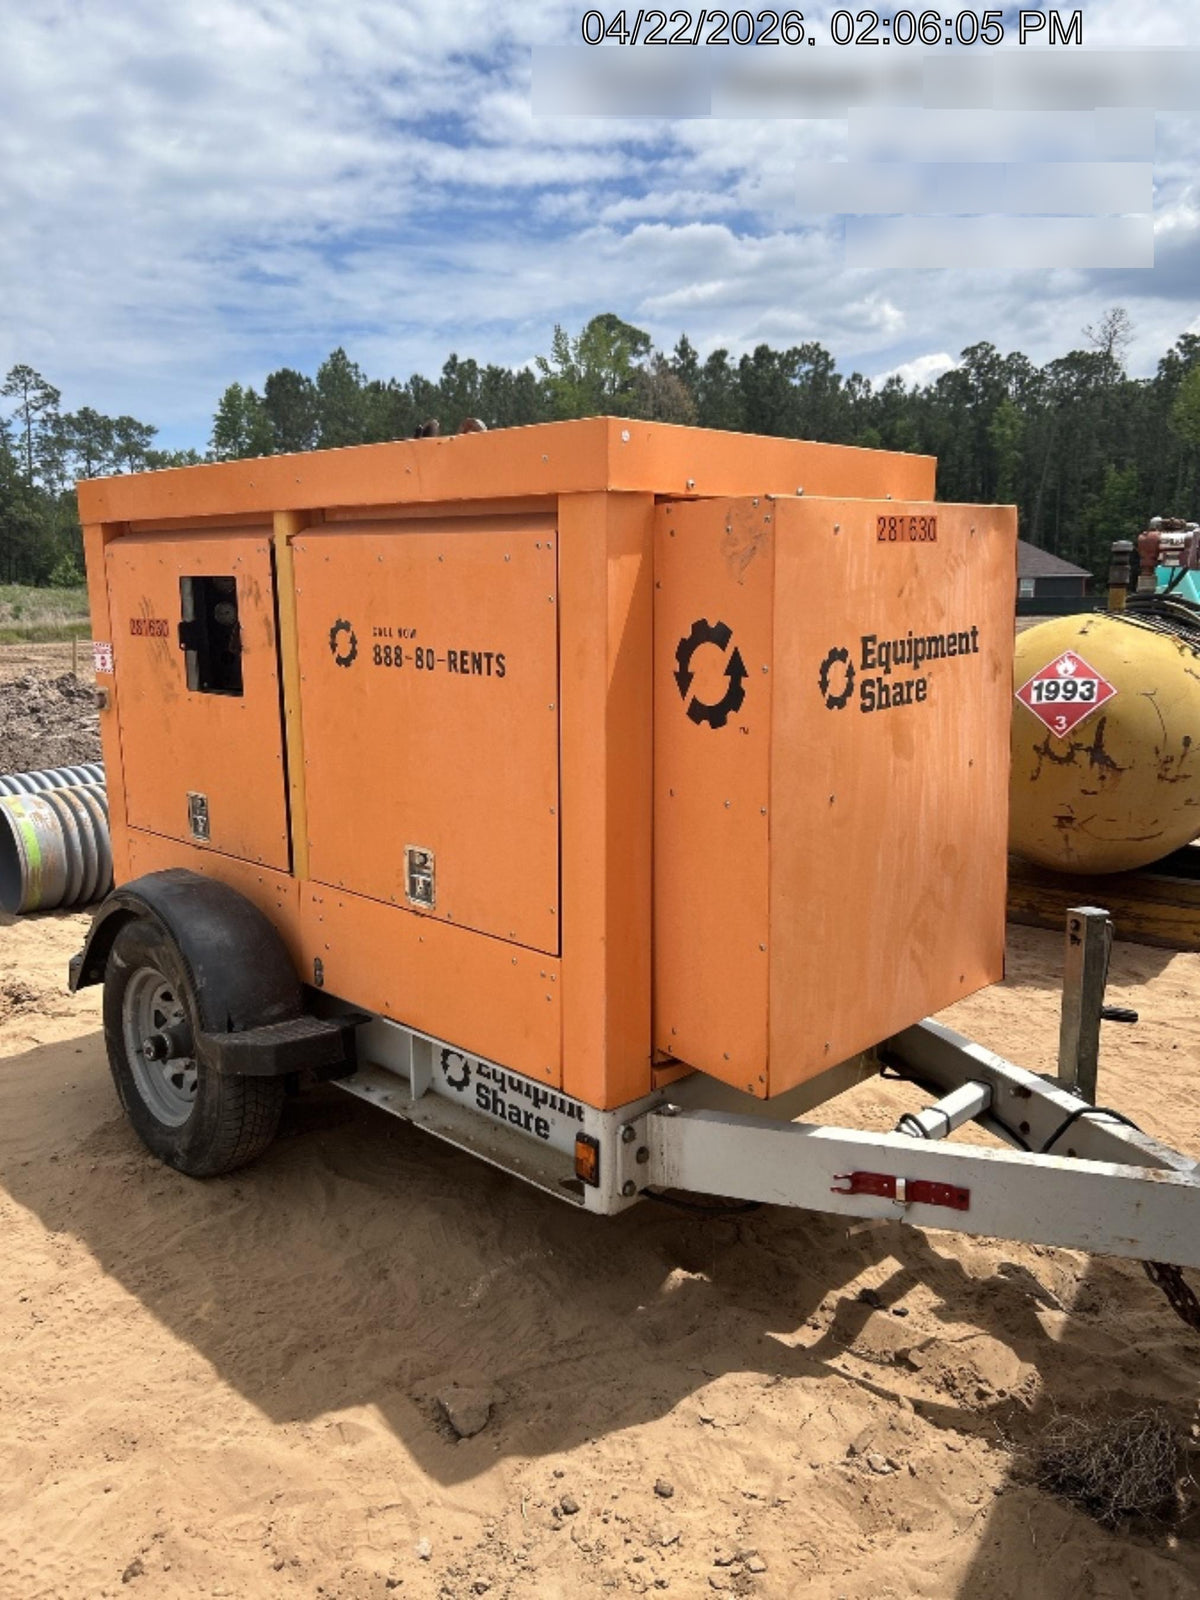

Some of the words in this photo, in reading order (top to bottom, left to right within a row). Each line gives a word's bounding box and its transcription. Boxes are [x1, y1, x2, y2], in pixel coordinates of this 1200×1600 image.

[877, 517, 936, 542] 281630
[130, 619, 169, 637] 281630
[373, 644, 506, 678] 888-80-RENTS
[860, 626, 979, 674] Equipment
[860, 676, 927, 713] Share
[1033, 680, 1096, 702] 1993
[1055, 716, 1067, 730] 3
[476, 1082, 550, 1140] Share
